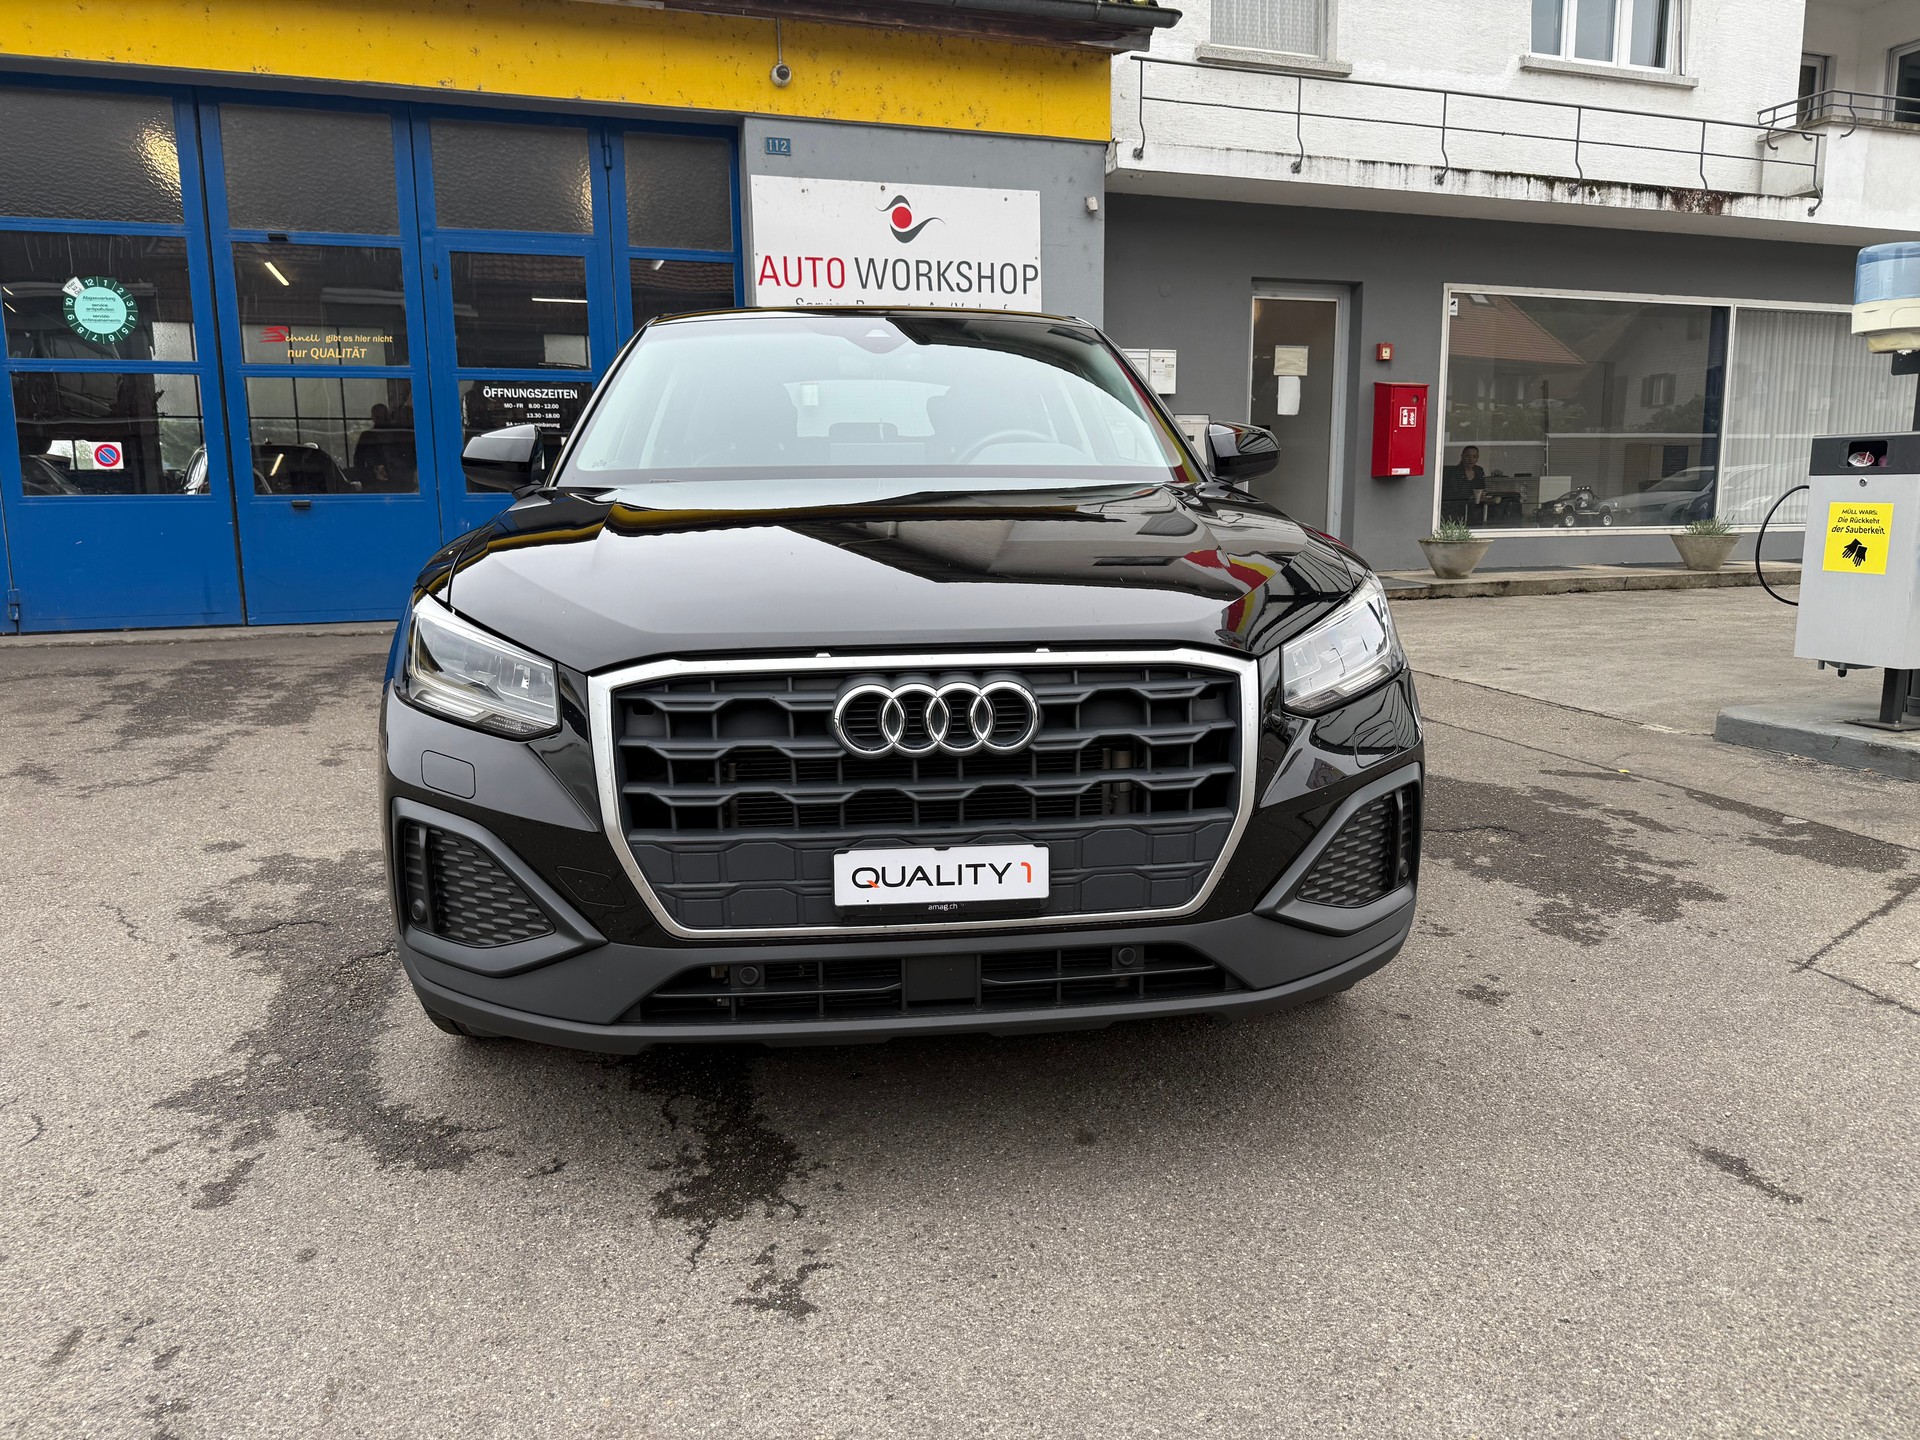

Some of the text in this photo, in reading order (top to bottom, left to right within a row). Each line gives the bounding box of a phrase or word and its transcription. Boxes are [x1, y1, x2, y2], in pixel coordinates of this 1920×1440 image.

[768, 138, 787, 152] 112
[758, 255, 1039, 294] AUTO WORKSHOP
[85, 278, 94, 286] 12
[65, 297, 74, 306] 10
[121, 327, 129, 335] 5
[325, 335, 341, 343] gibt
[354, 334, 371, 342] hier
[372, 335, 393, 343] nicht
[287, 346, 367, 359] nur QUALITÄT
[483, 386, 578, 398] ÖFFNUNGSZEITEN
[1831, 525, 1844, 533] der
[852, 862, 1012, 888] QUALITY
[928, 902, 958, 911] amag.ch
